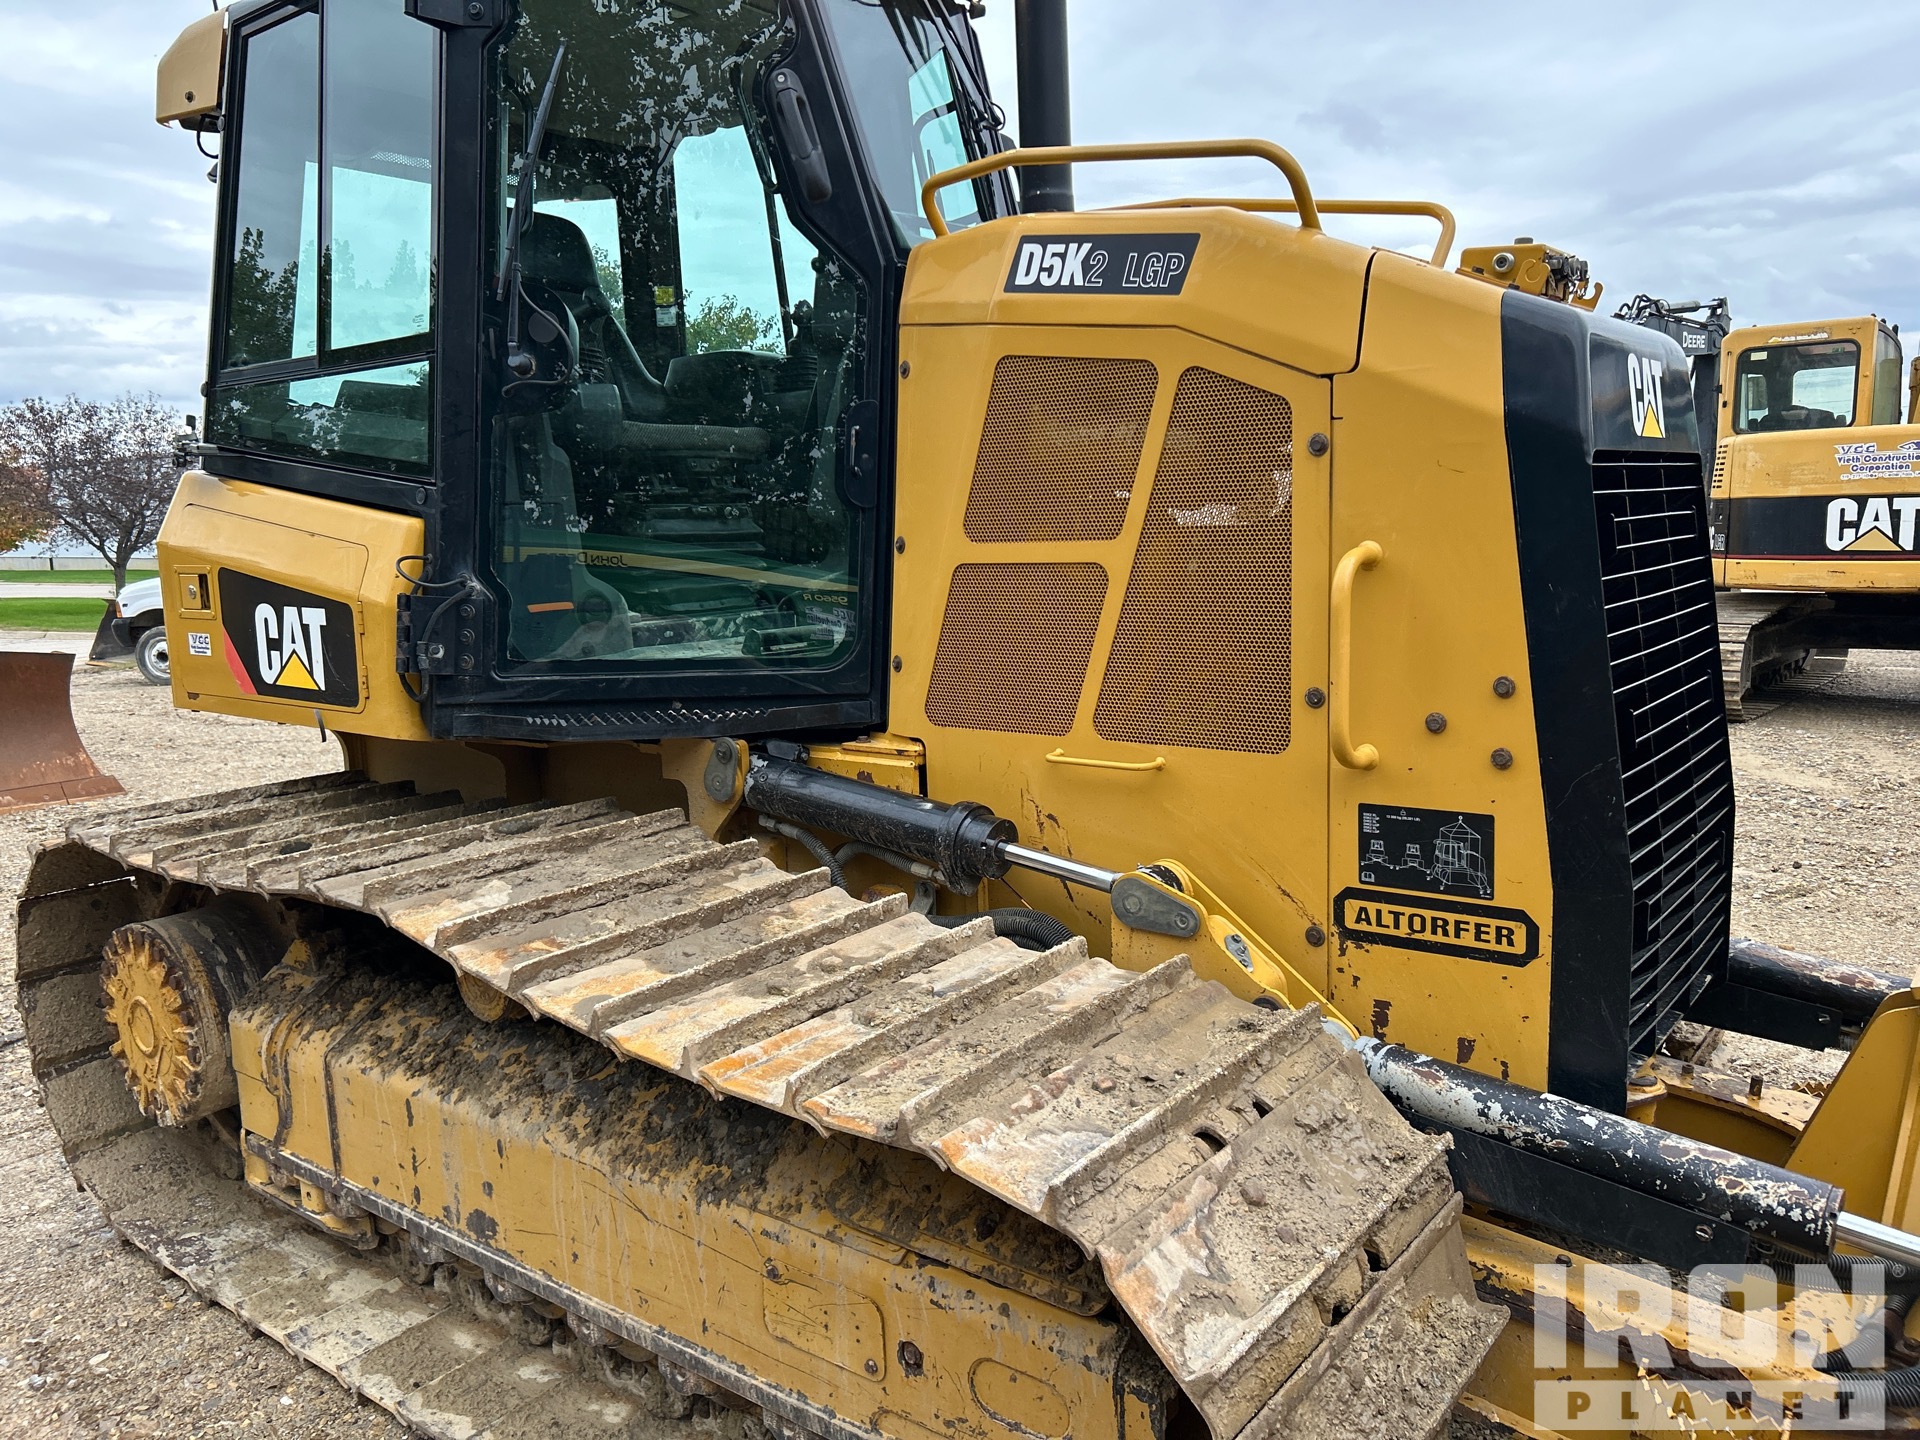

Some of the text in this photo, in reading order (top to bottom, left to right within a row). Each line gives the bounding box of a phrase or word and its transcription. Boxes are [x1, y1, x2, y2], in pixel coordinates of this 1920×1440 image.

[1122, 251, 1186, 288] LGP
[1682, 331, 1706, 349] DEERE
[1627, 352, 1666, 439] CAT
[1837, 453, 1920, 464] Vieth Constructio
[1851, 463, 1911, 473] Corporation
[1825, 497, 1920, 552] CAT
[254, 602, 327, 692] CAT
[1354, 905, 1516, 948] ALTORFER
